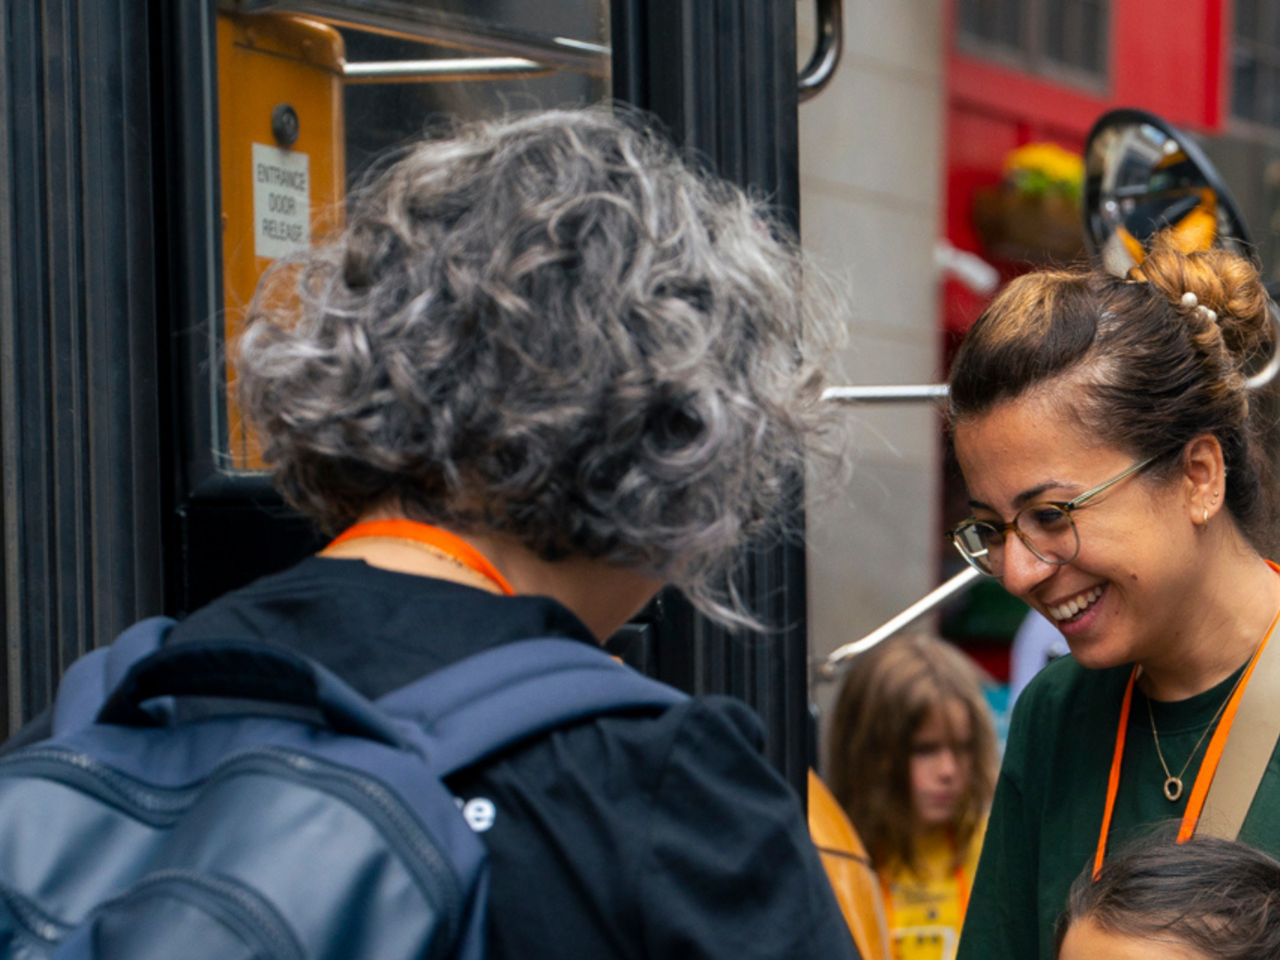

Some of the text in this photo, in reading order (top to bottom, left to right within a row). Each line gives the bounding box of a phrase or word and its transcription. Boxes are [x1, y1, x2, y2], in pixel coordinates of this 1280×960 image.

[257, 162, 306, 193] ENTRANCE
[267, 191, 297, 215] DOOR
[262, 218, 304, 243] RELEASE
